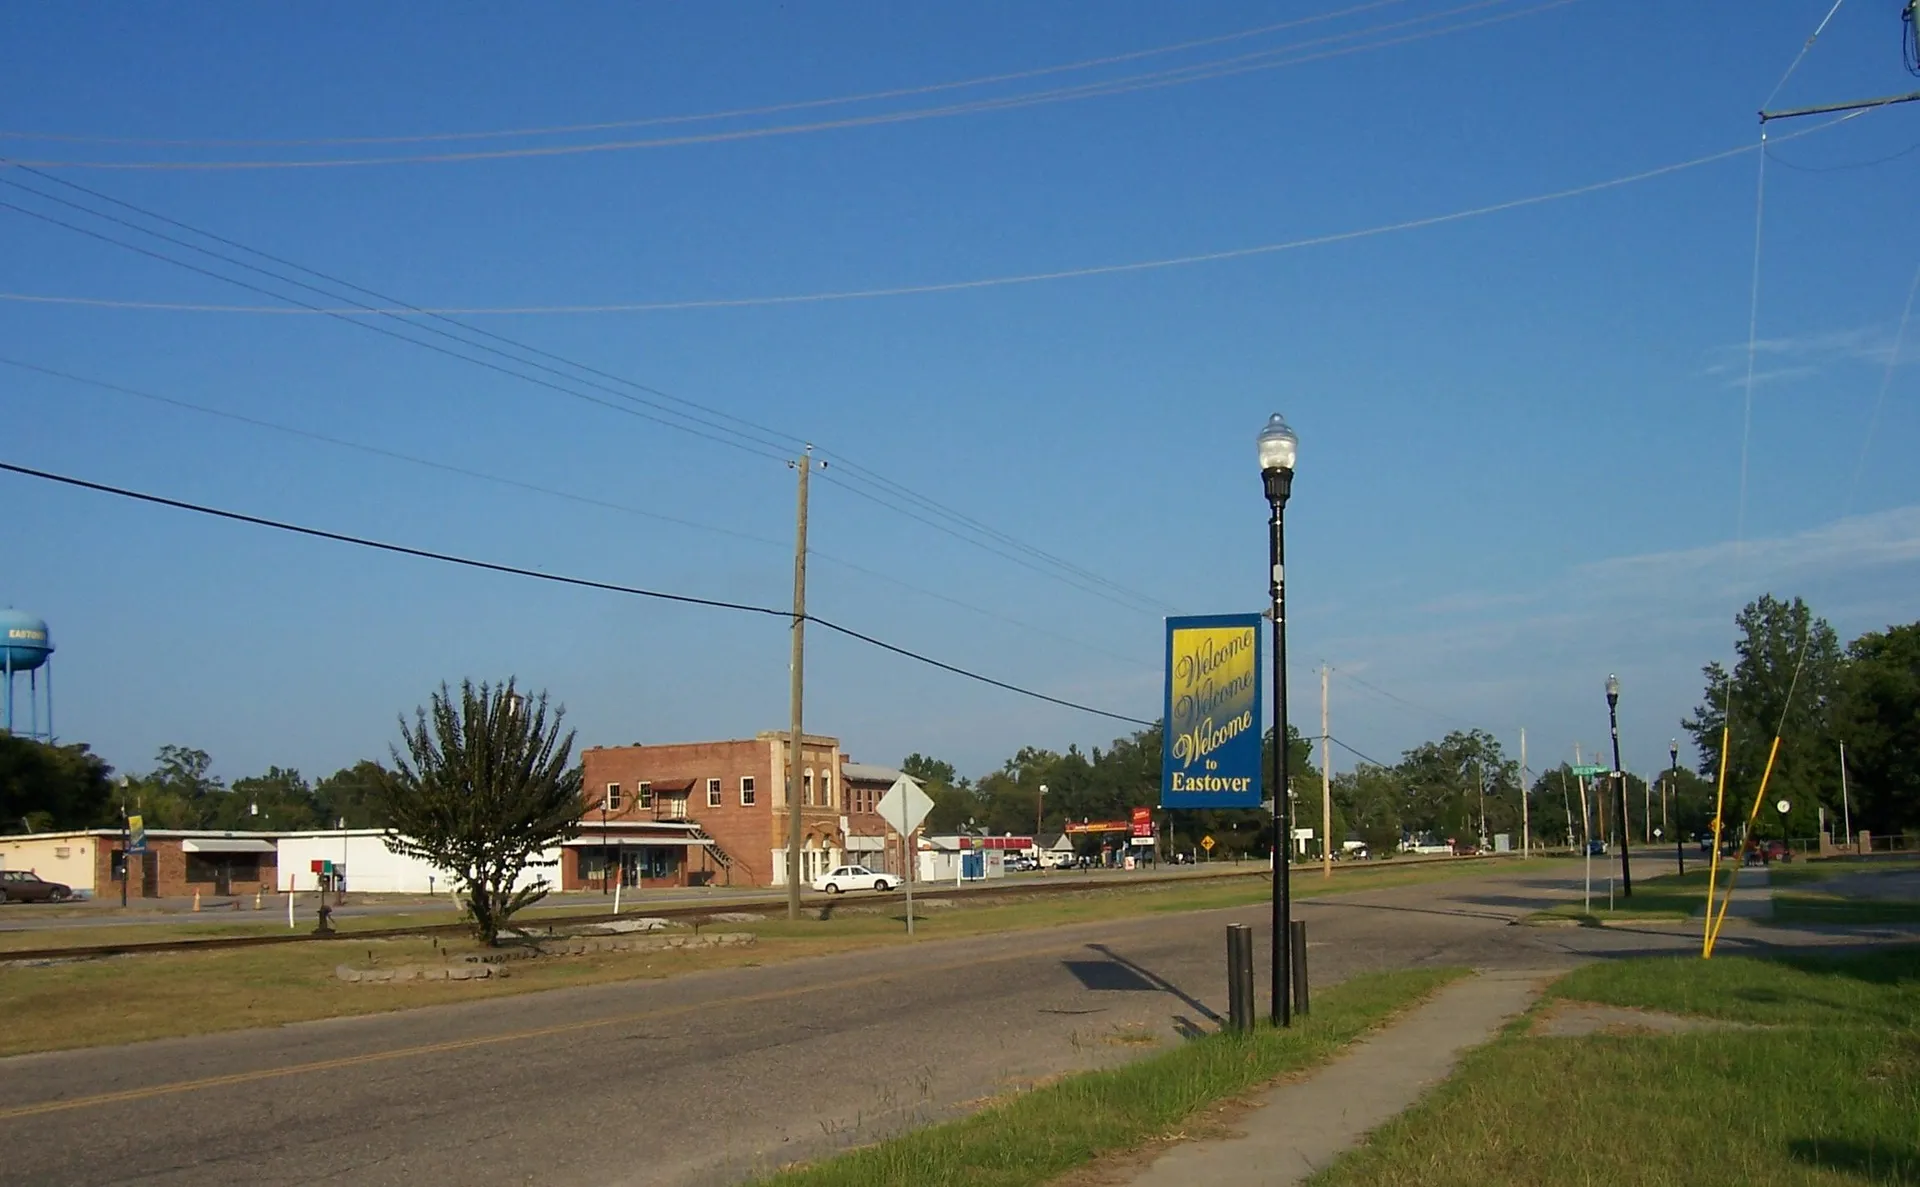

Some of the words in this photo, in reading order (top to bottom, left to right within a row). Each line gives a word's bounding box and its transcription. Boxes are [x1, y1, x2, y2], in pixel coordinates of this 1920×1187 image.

[1177, 630, 1252, 687] Welcome
[1175, 670, 1252, 726] Welcome
[1173, 711, 1252, 767] Welcome
[1206, 759, 1217, 770] to
[1173, 772, 1250, 792] Eastover
